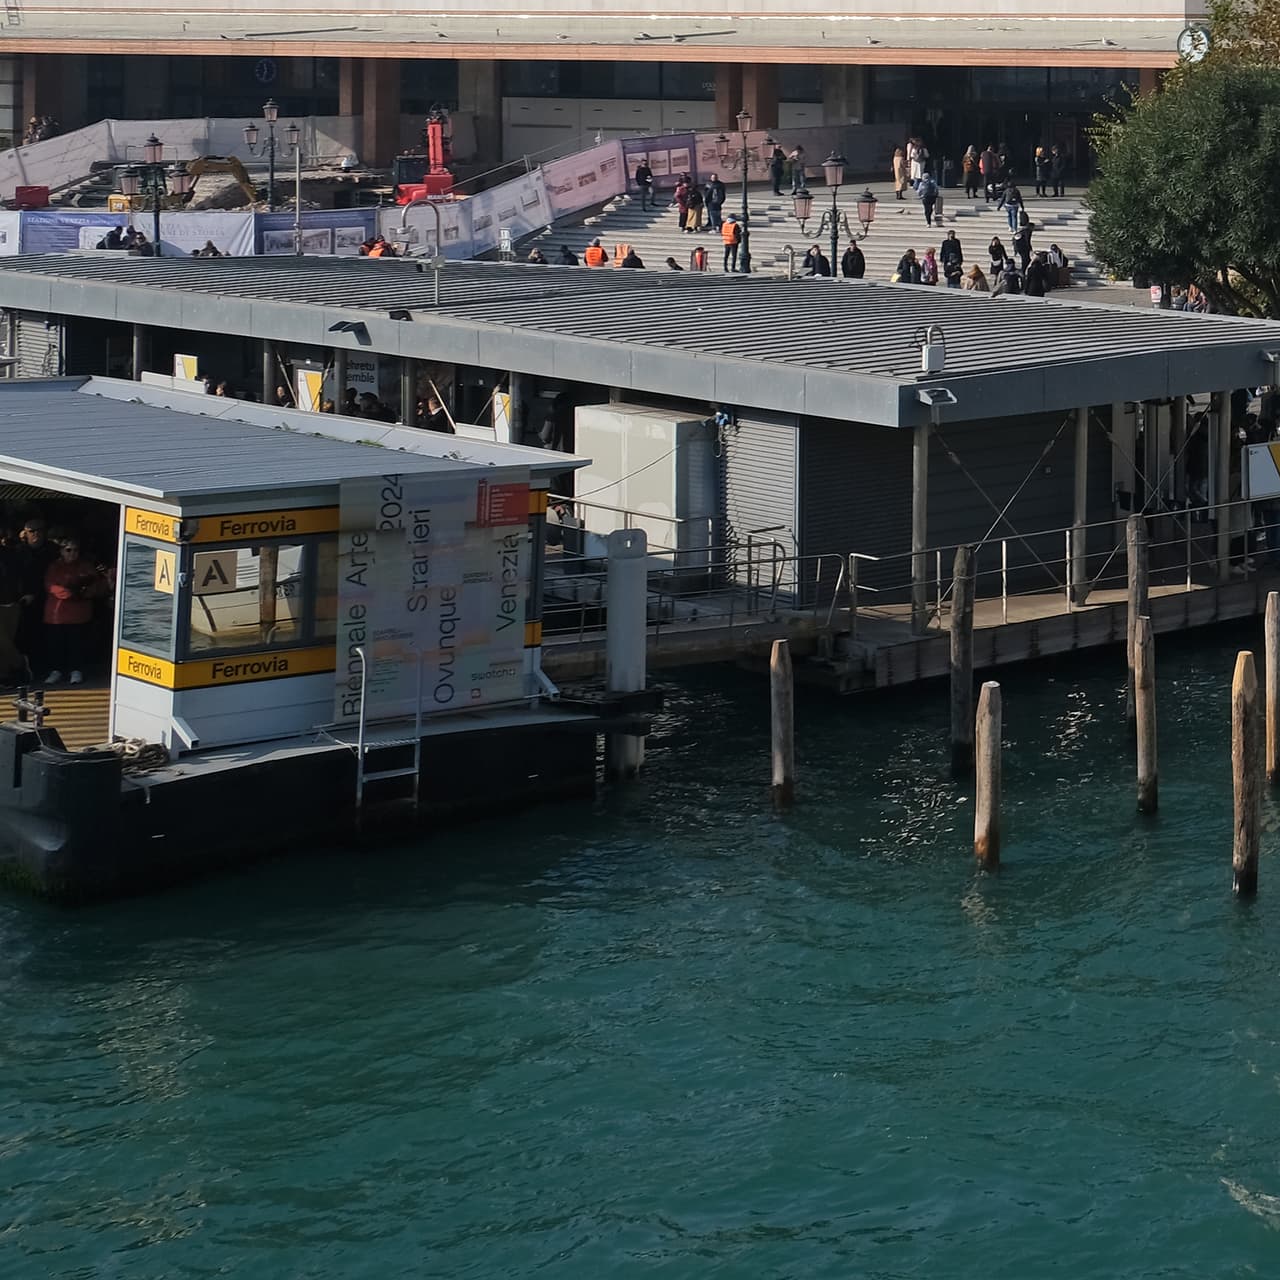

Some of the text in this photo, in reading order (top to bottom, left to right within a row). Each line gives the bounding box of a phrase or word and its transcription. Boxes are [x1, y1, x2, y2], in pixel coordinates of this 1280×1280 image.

[135, 514, 170, 537] Ferrovia
[219, 515, 297, 537] Ferrovia
[159, 559, 171, 586] A
[202, 559, 229, 587] A
[495, 532, 519, 632] Venezia
[432, 583, 461, 705] Ovunque
[127, 655, 162, 680] Ferrovia
[211, 656, 289, 680] Ferrovia
[342, 603, 368, 717] Biennale
